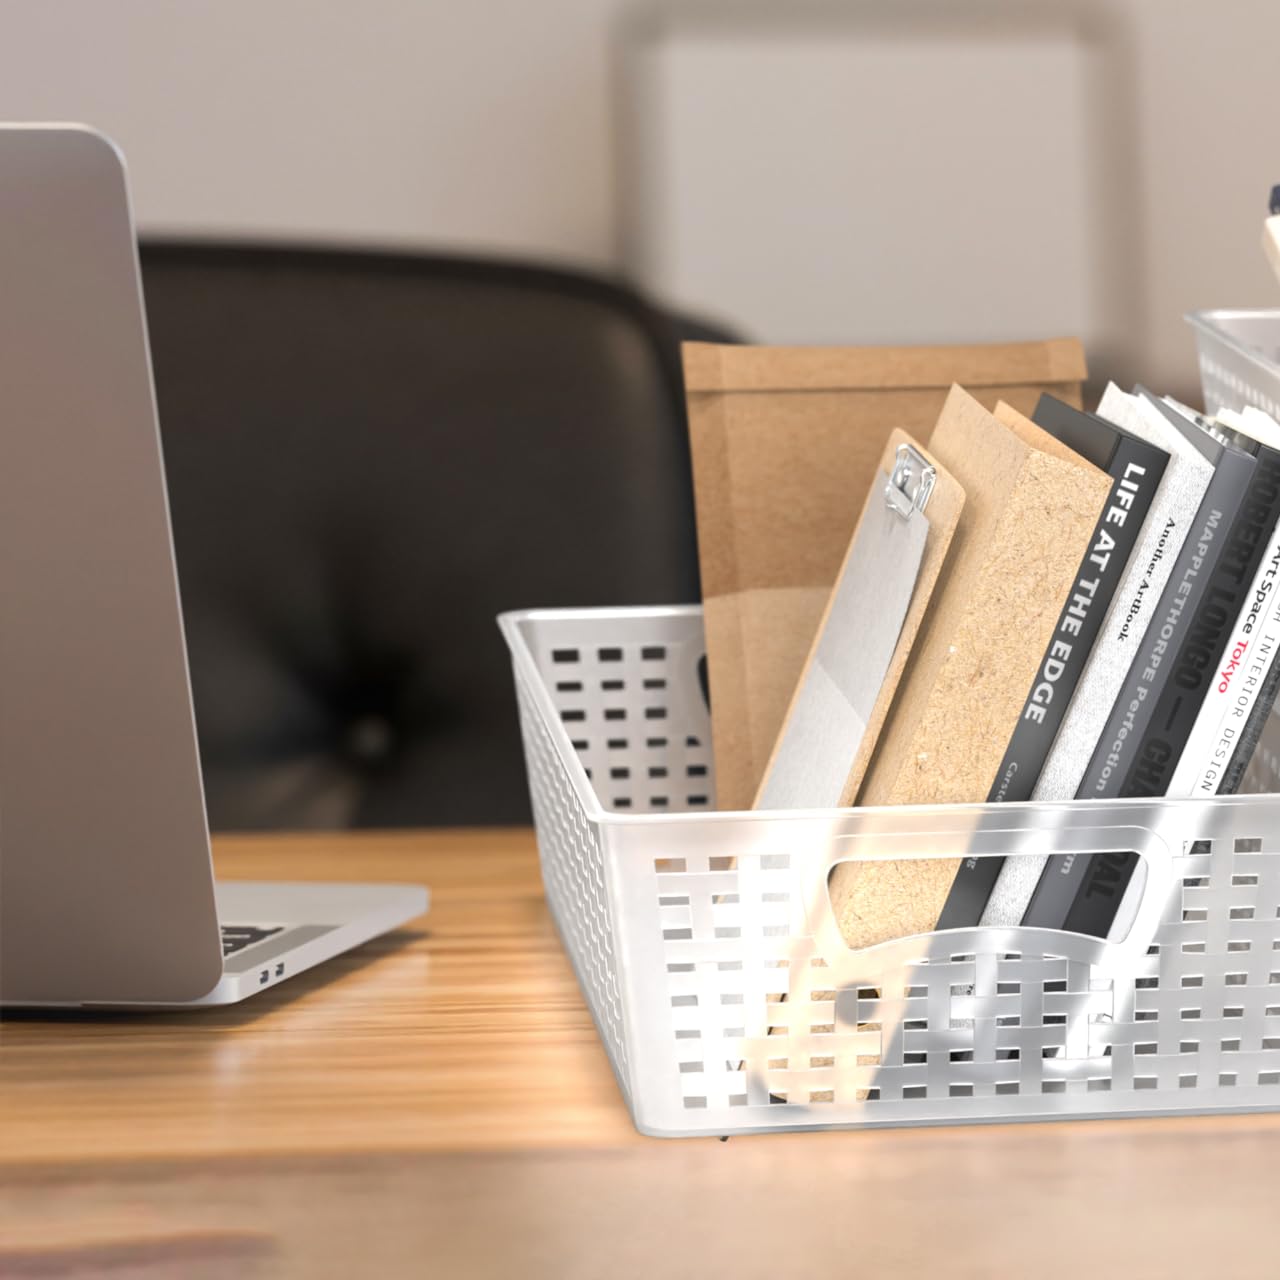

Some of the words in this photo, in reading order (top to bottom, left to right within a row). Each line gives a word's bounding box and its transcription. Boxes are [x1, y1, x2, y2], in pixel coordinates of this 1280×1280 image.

[1106, 462, 1146, 528] LIFE
[1090, 529, 1116, 572] AT
[1148, 517, 1176, 578] Another
[1060, 577, 1101, 637] THE
[1142, 509, 1223, 683] MAPPLETHORPE
[1173, 586, 1236, 691] LONGO
[1217, 640, 1249, 694] Tokyo
[1024, 639, 1073, 725] EDGE
[1231, 634, 1276, 718] INTERIOR
[1095, 685, 1149, 792] Perfection
[1200, 727, 1236, 792] DESIGN
[994, 762, 1018, 802] Carste
